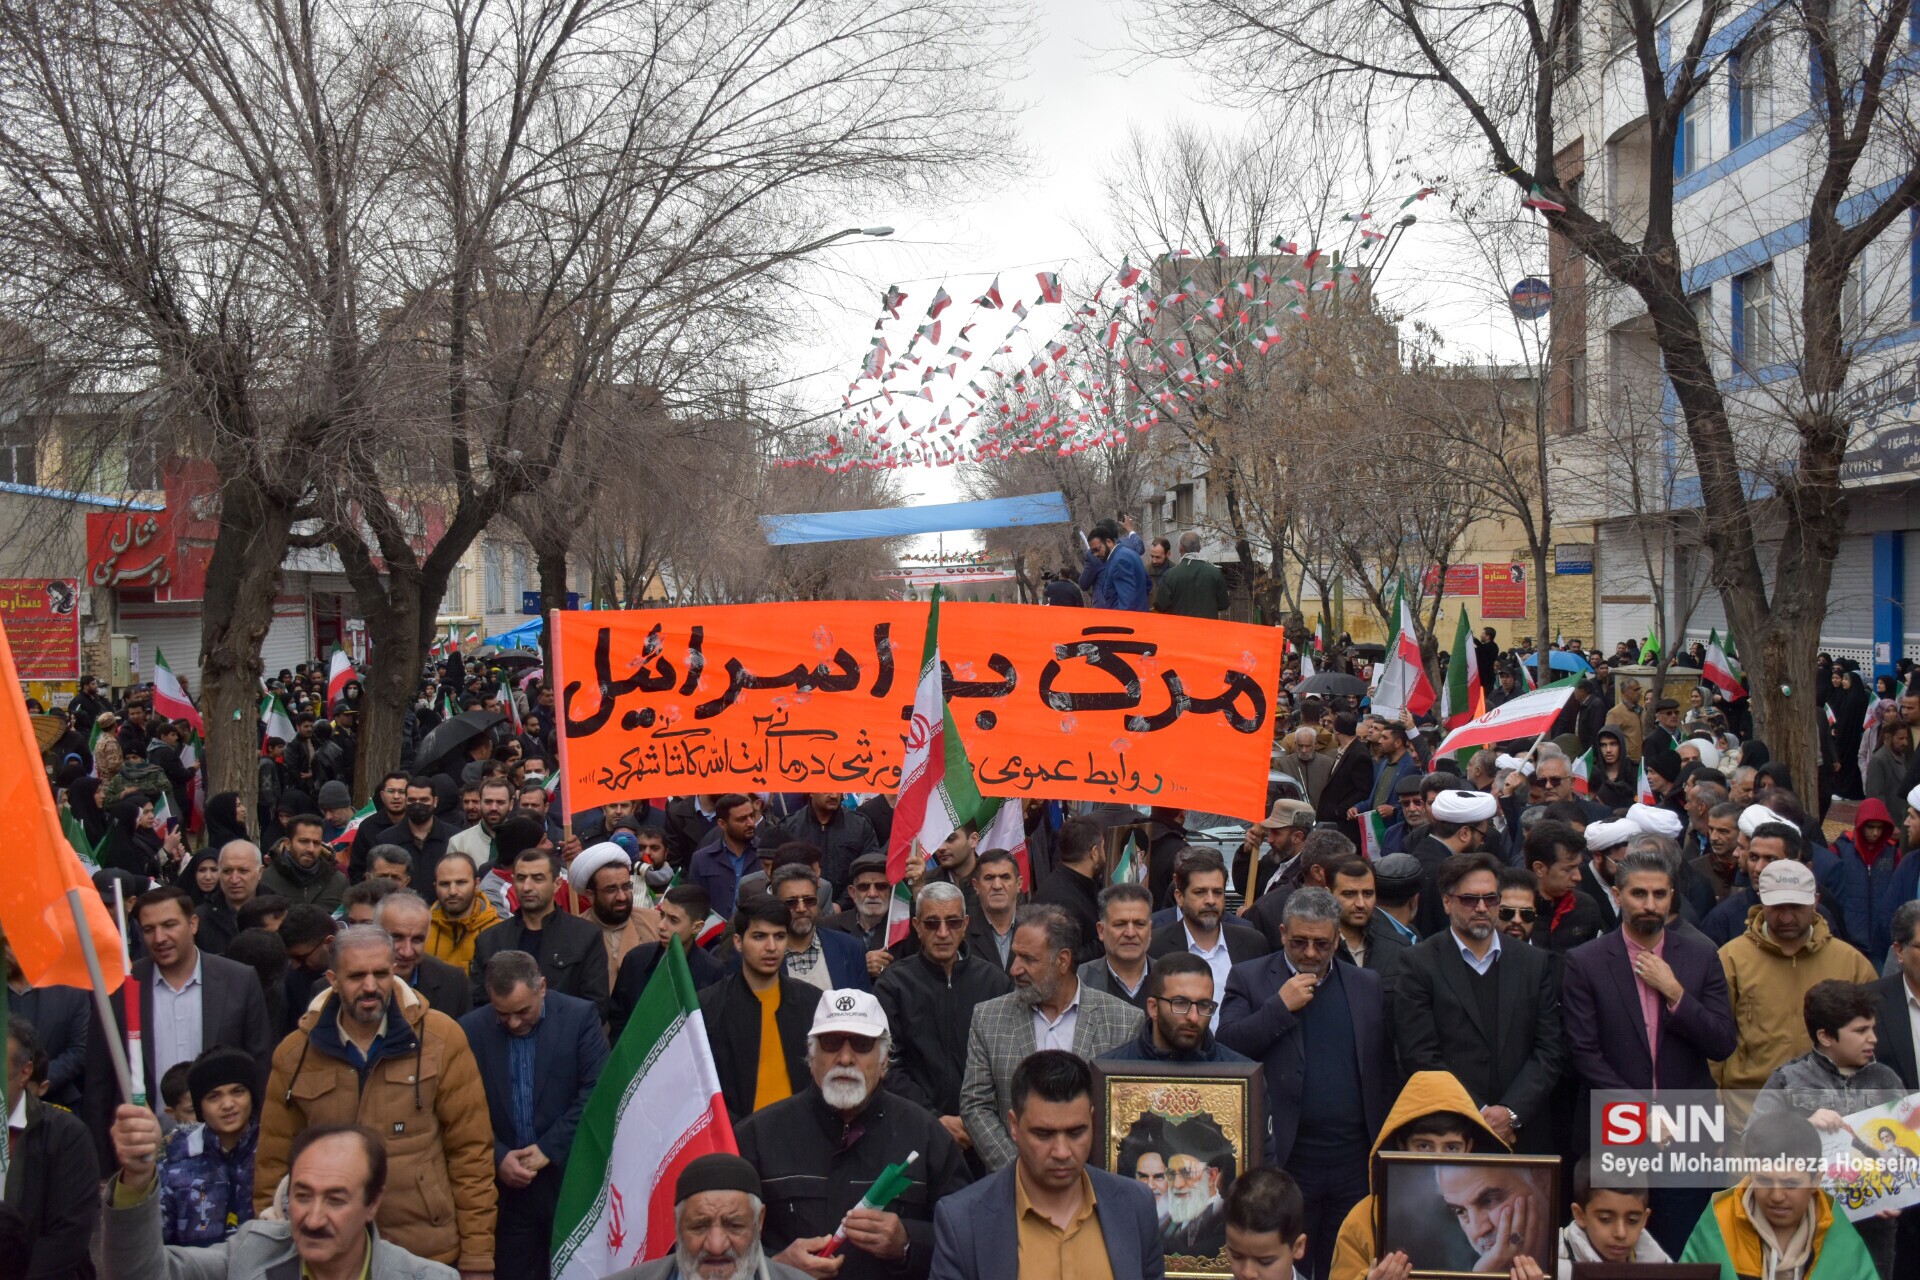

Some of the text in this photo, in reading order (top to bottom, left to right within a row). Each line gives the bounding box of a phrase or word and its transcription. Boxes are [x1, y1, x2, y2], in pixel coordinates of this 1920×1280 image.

[111, 516, 158, 553] شال
[93, 554, 171, 587] روسری
[1484, 571, 1507, 582] ستاره
[0, 592, 41, 613] ستاره
[1039, 626, 1267, 734] مرگ
[597, 744, 661, 791] شهرکرد
[979, 755, 1078, 790] عمومی
[1084, 751, 1163, 794] روابط
[1776, 875, 1800, 884] Jeep
